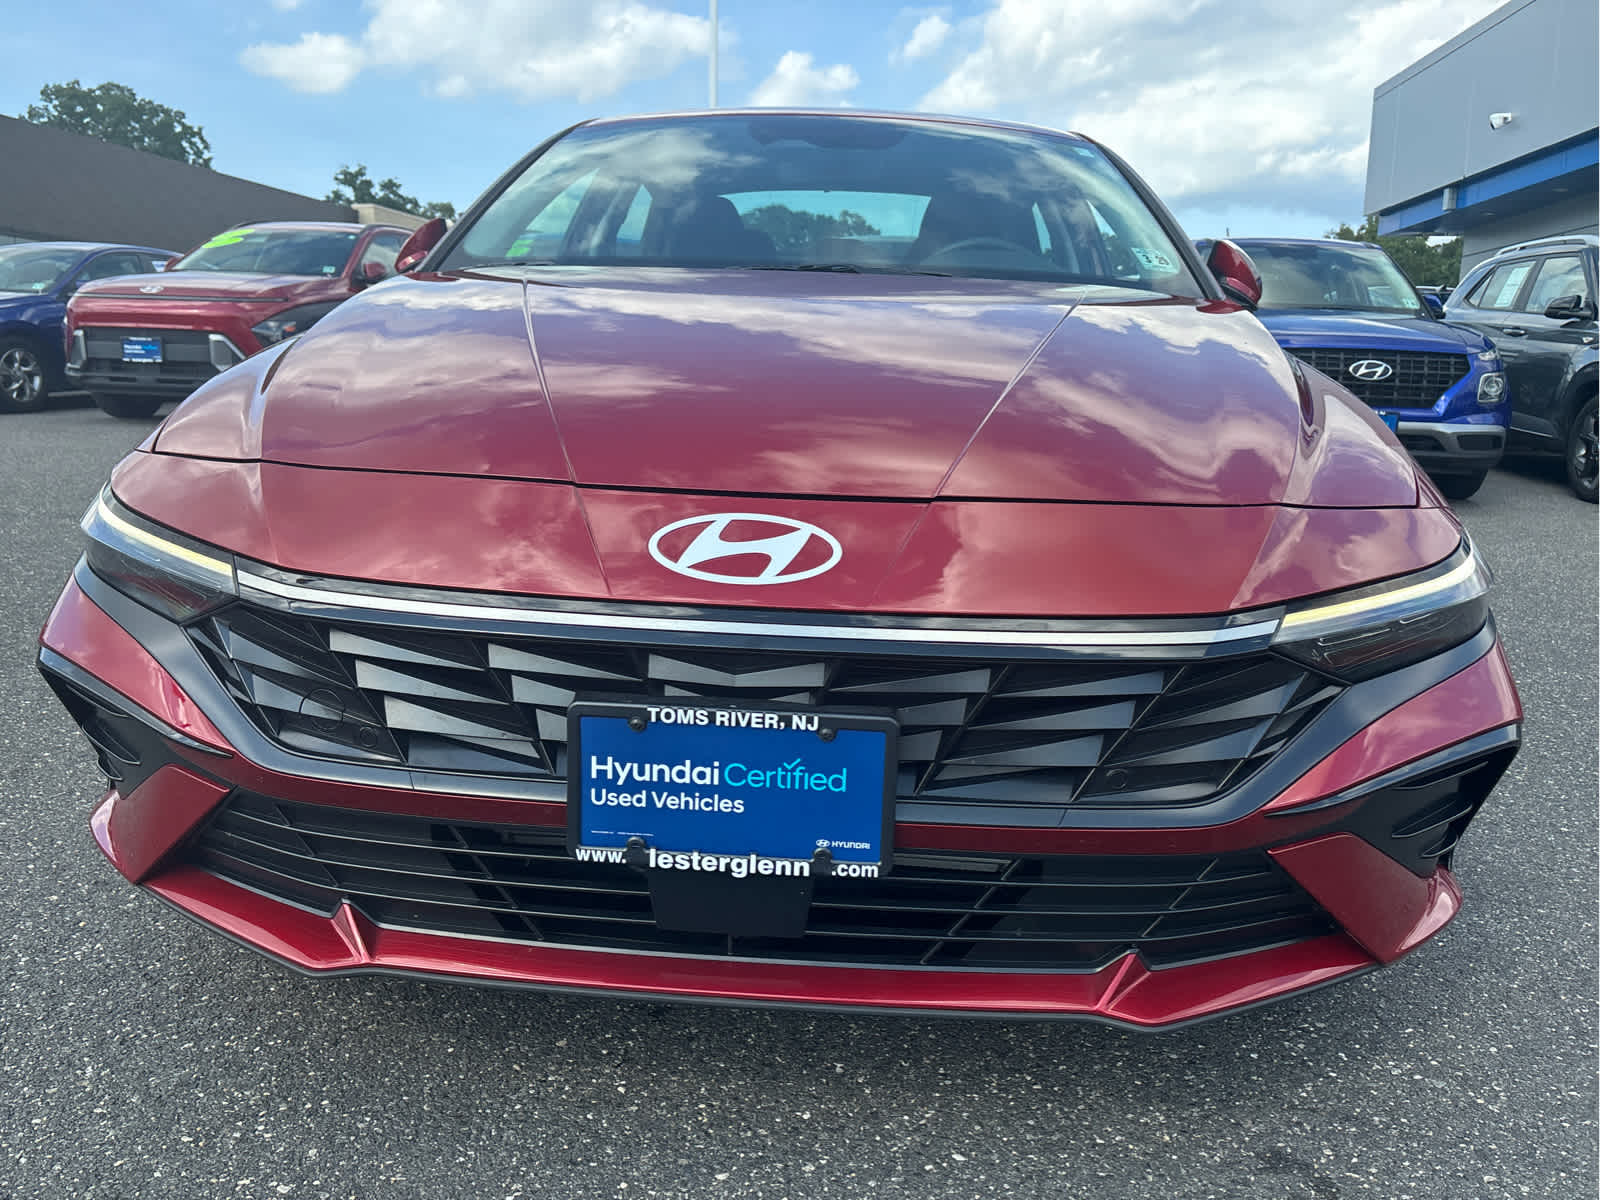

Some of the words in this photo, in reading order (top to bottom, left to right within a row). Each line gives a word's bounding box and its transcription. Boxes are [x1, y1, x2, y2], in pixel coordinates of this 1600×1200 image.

[647, 707, 709, 726] TOMS
[715, 711, 785, 730] RIVER,
[791, 714, 819, 731] NJ
[591, 755, 720, 785] Hyundai
[724, 757, 847, 792] Certified
[591, 788, 647, 808] Used
[651, 790, 745, 813] Vehicles
[831, 840, 871, 850] HYUNDAI
[649, 848, 810, 878] lesterglenn
